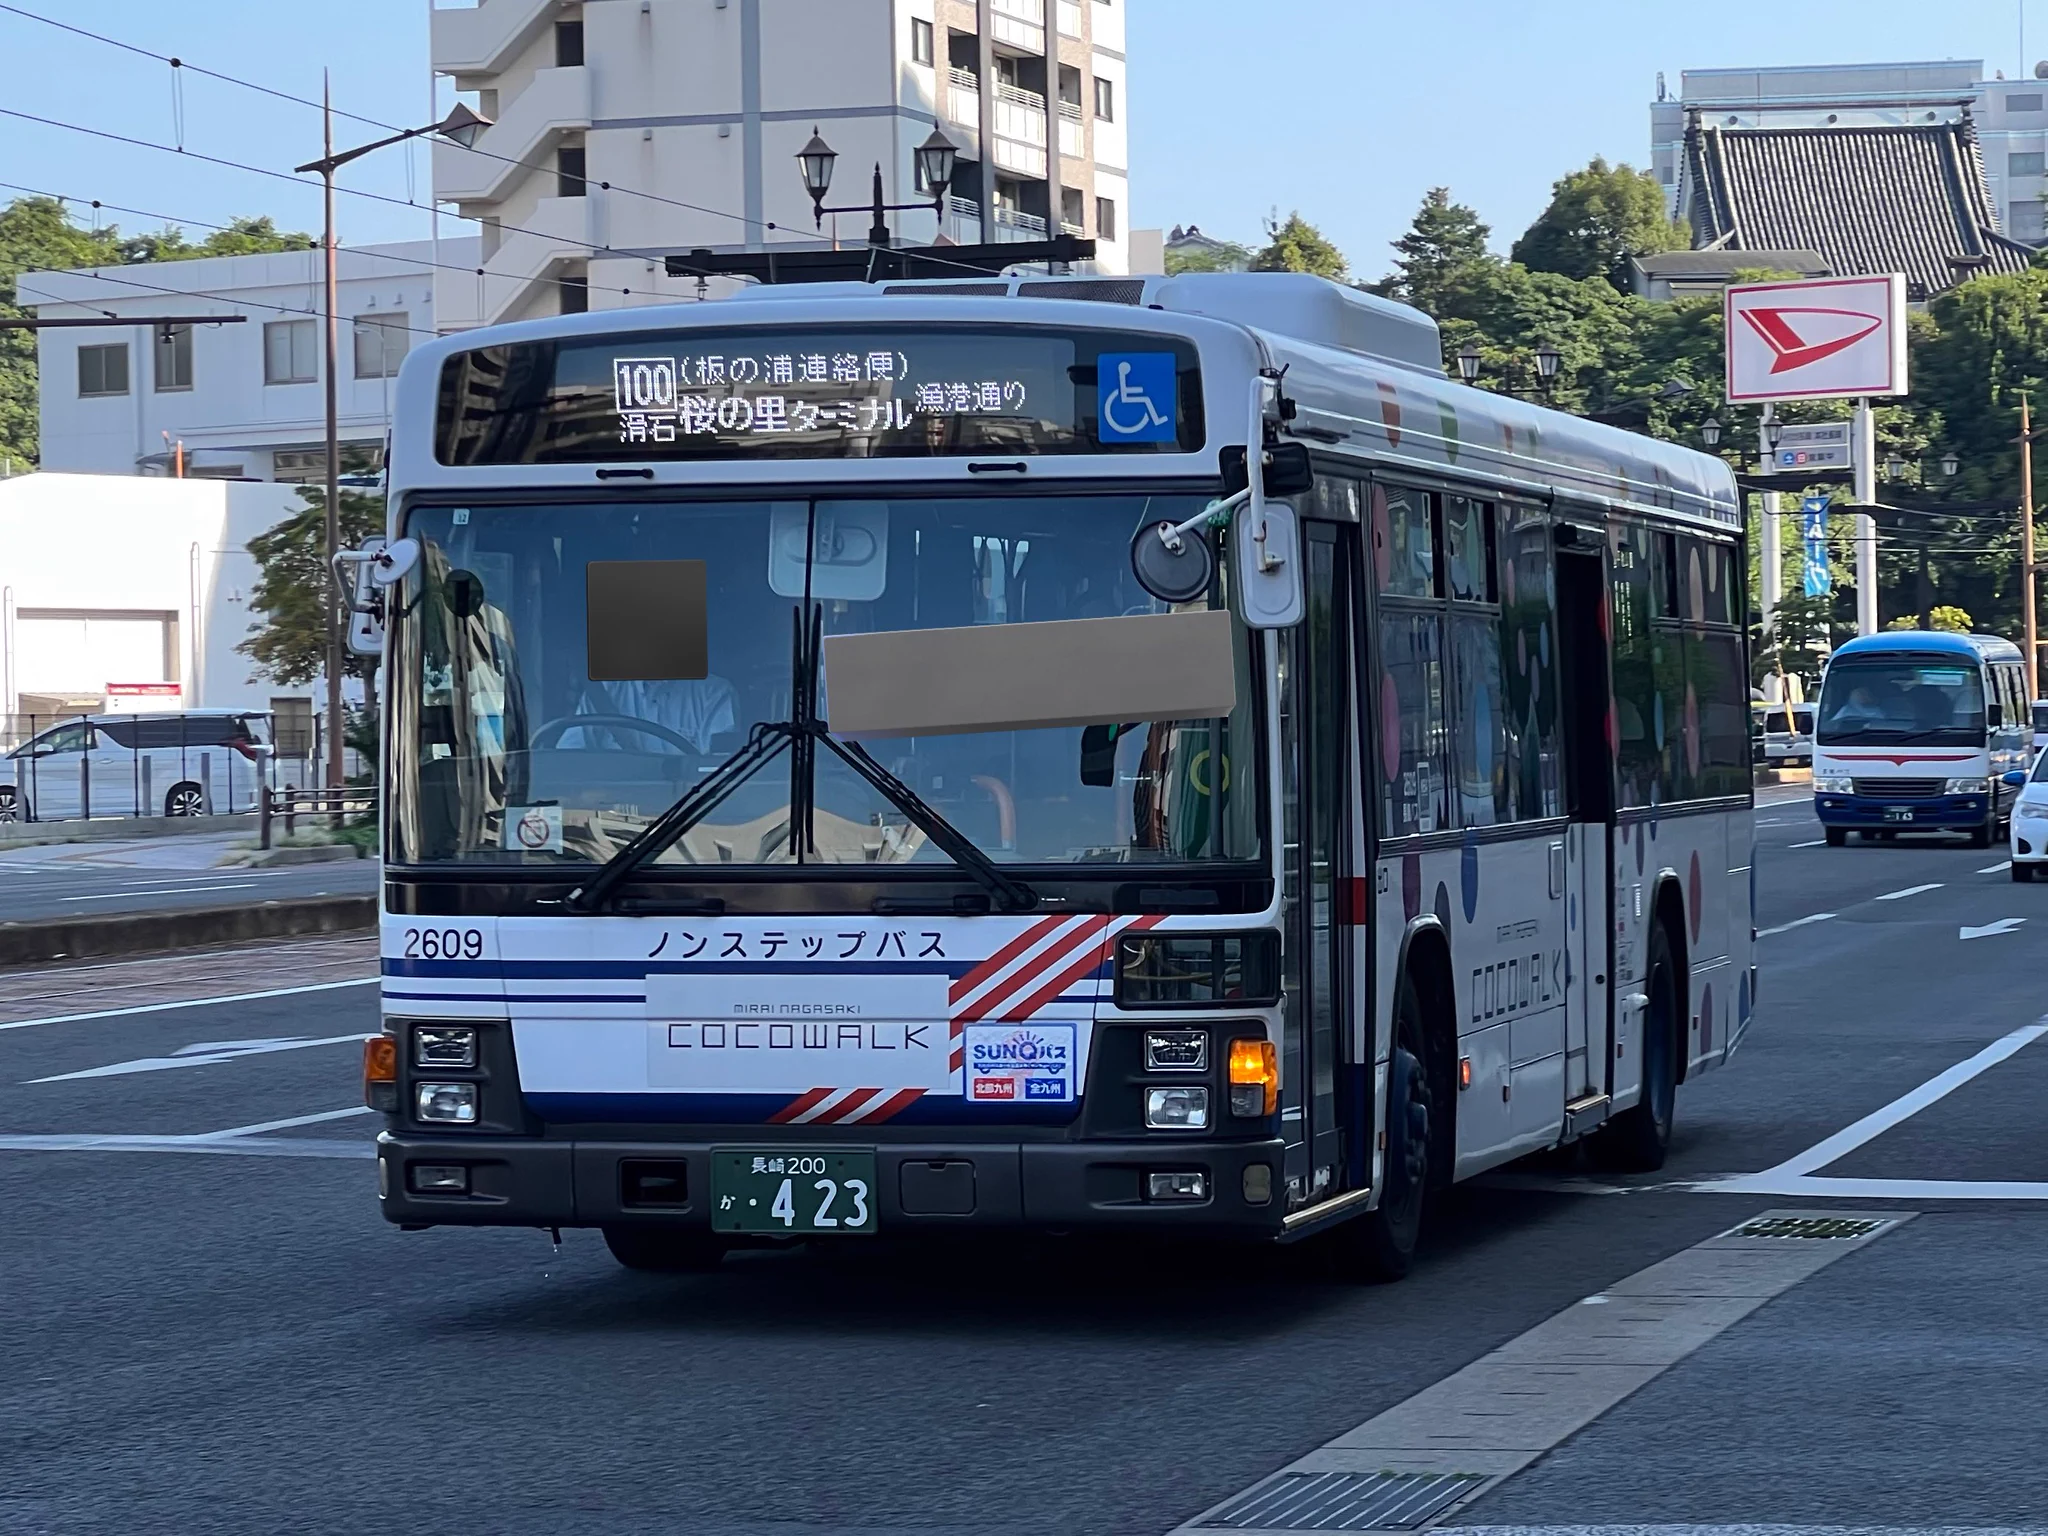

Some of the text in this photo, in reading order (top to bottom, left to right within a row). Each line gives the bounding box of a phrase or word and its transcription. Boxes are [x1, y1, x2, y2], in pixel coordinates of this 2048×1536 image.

[619, 364, 674, 406] 100
[915, 381, 1026, 412] 漁港通り
[619, 413, 677, 443] 滑石
[678, 395, 914, 434] 桜の里ターミナル
[404, 928, 483, 960] 2609
[648, 931, 946, 959] ノンステップバス
[733, 1004, 861, 1015] MIRAI NAGASAKI
[668, 1023, 930, 1050] COCOWALK
[1030, 1083, 1061, 1095] 全九州
